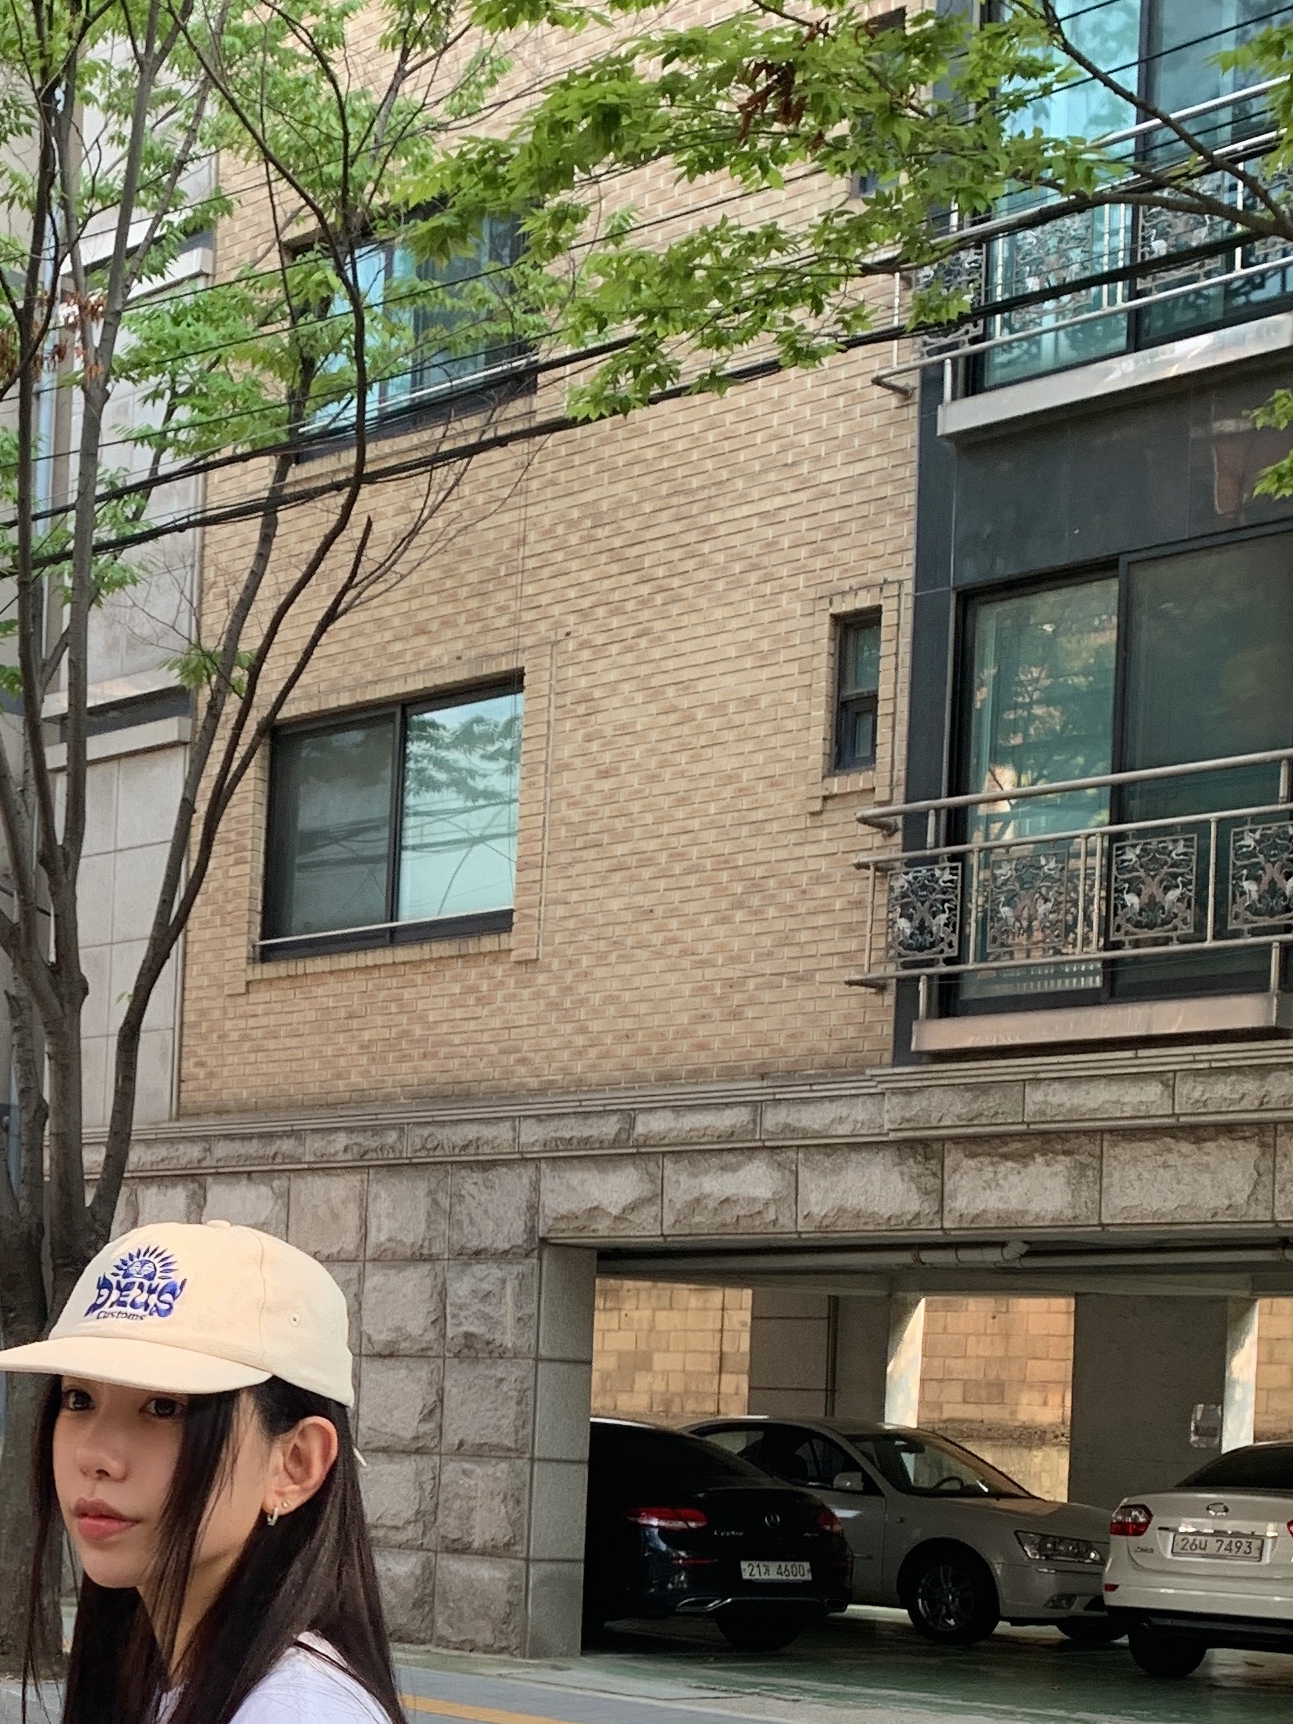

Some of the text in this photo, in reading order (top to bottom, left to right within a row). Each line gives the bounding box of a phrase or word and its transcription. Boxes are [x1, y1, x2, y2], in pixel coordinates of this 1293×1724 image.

[84, 1273, 188, 1318] DEUS
[1216, 1538, 1253, 1555] 7493
[776, 1563, 806, 1578] 4600
